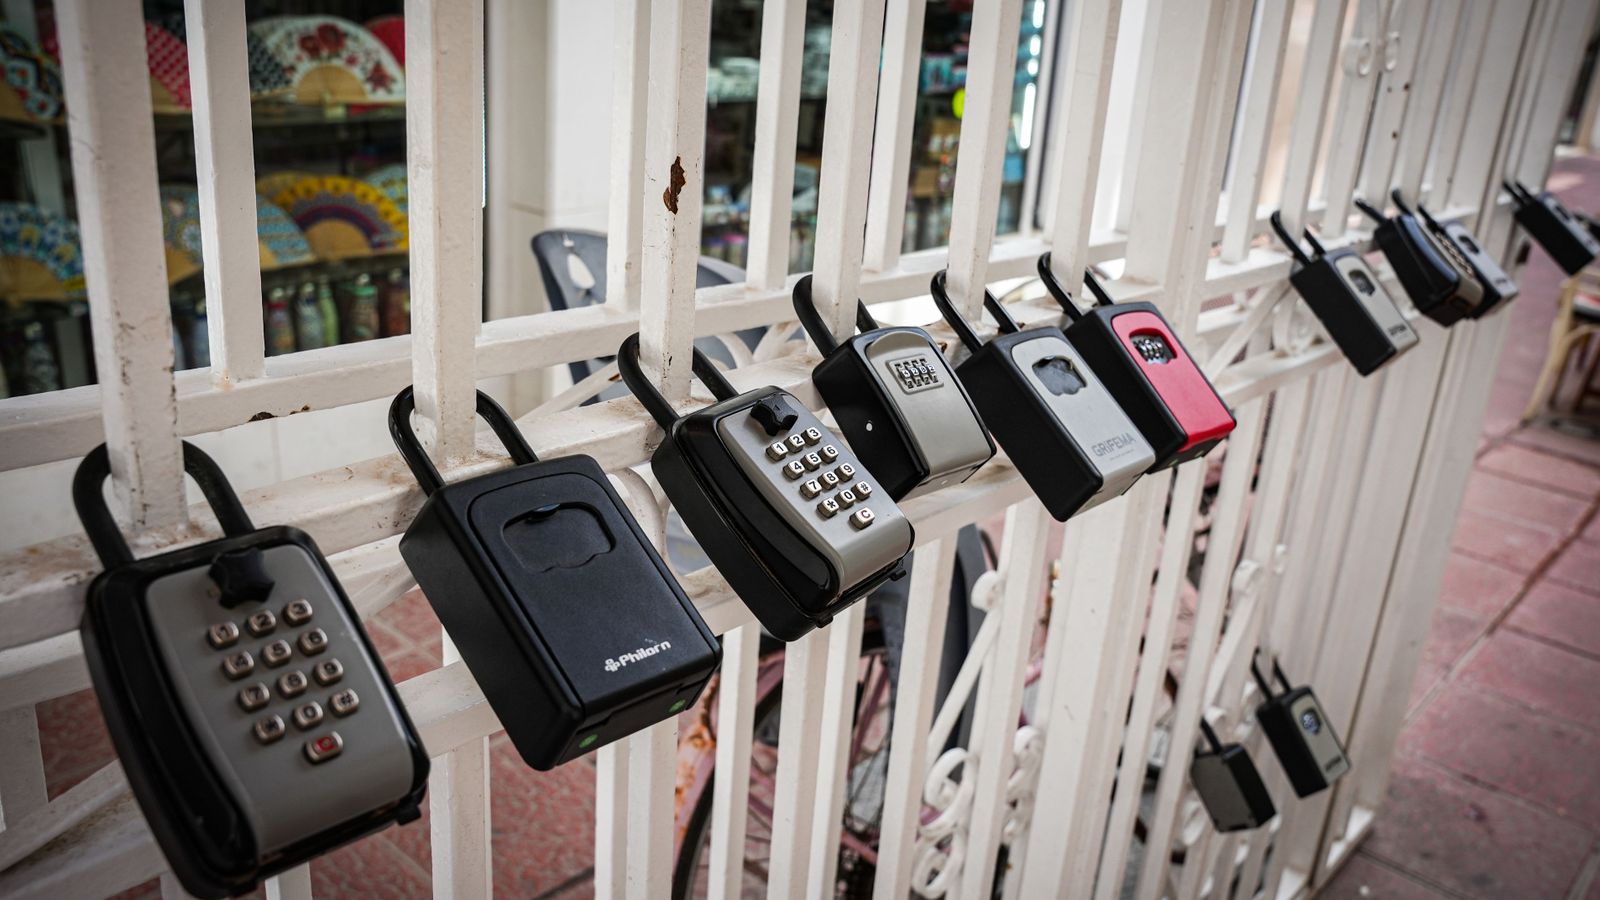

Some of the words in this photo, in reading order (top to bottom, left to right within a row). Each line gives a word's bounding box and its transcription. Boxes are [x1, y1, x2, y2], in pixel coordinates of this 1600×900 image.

[256, 614, 271, 627] 2
[293, 603, 308, 615] 3
[272, 643, 286, 656] 5
[308, 631, 322, 644] 6
[618, 641, 672, 667] Philorn
[324, 663, 338, 675] 9
[303, 705, 317, 719] 0
